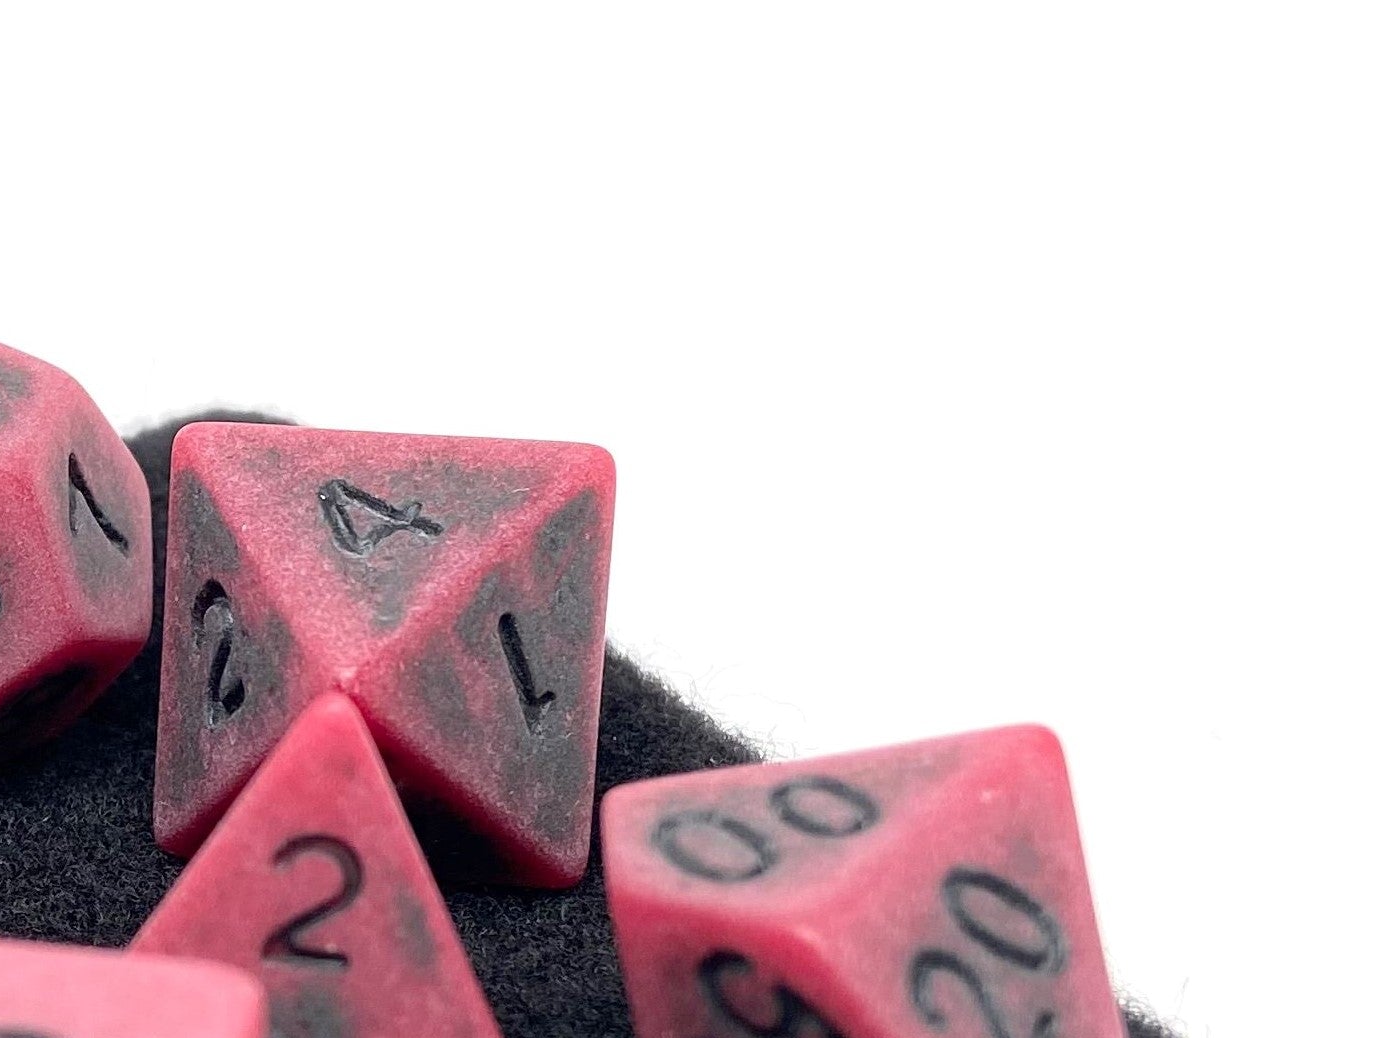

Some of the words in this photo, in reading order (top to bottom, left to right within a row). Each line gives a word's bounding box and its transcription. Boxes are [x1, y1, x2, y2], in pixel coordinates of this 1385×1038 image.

[316, 477, 444, 557] 4
[192, 578, 248, 730] 2
[648, 774, 882, 884] 00
[260, 832, 365, 969] 2
